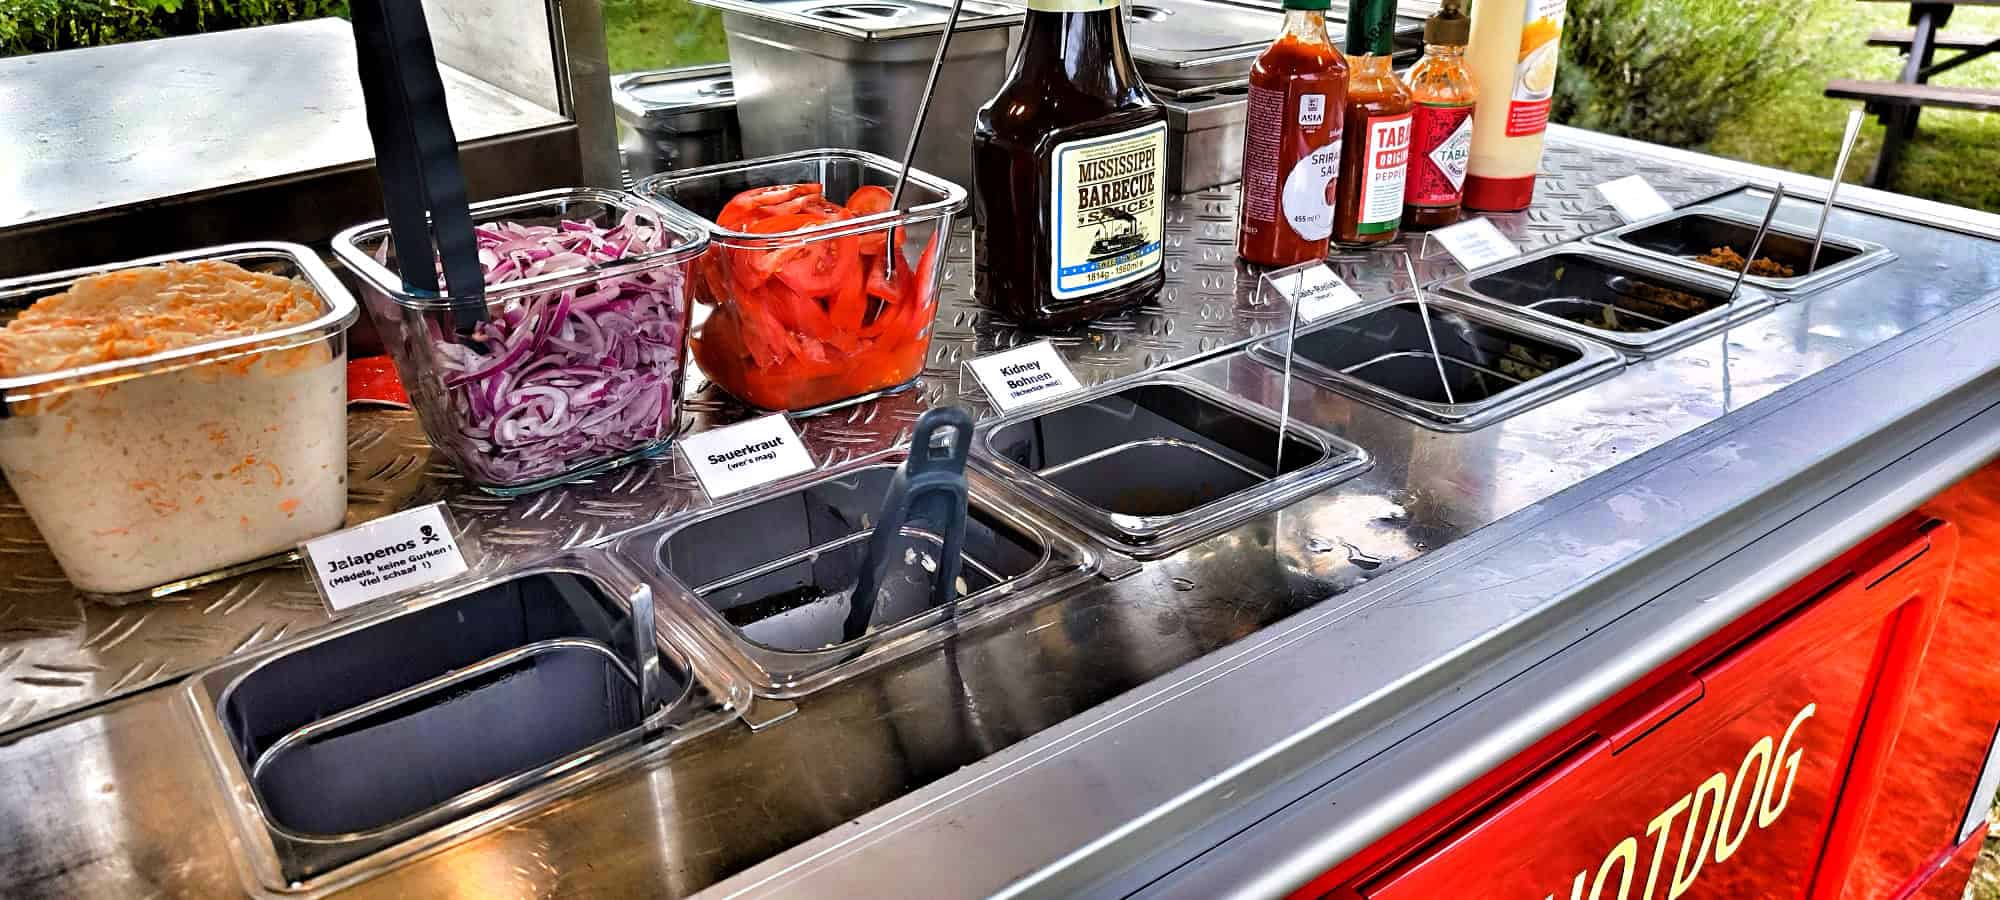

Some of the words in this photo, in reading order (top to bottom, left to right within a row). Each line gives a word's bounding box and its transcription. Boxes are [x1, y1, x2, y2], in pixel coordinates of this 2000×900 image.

[1300, 114, 1322, 122] ASIA
[1078, 148, 1156, 184] MISSISSIPPI
[1078, 171, 1155, 209] BARBECUE
[1087, 198, 1149, 223] SAUCE
[1294, 215, 1306, 223] 455
[1000, 361, 1041, 377] Kidney
[1007, 372, 1052, 389] Bohnen
[707, 436, 784, 465] Sauerkraut
[728, 458, 753, 471] (wer's
[755, 451, 777, 463] mag)
[327, 539, 417, 573] Jalapenos
[329, 569, 375, 588] (Mädels,
[377, 559, 407, 572] keine
[408, 547, 447, 563] Gurken
[360, 576, 381, 587] Viel
[383, 565, 417, 581] schaaf
[1545, 703, 1816, 900] OTDOG
